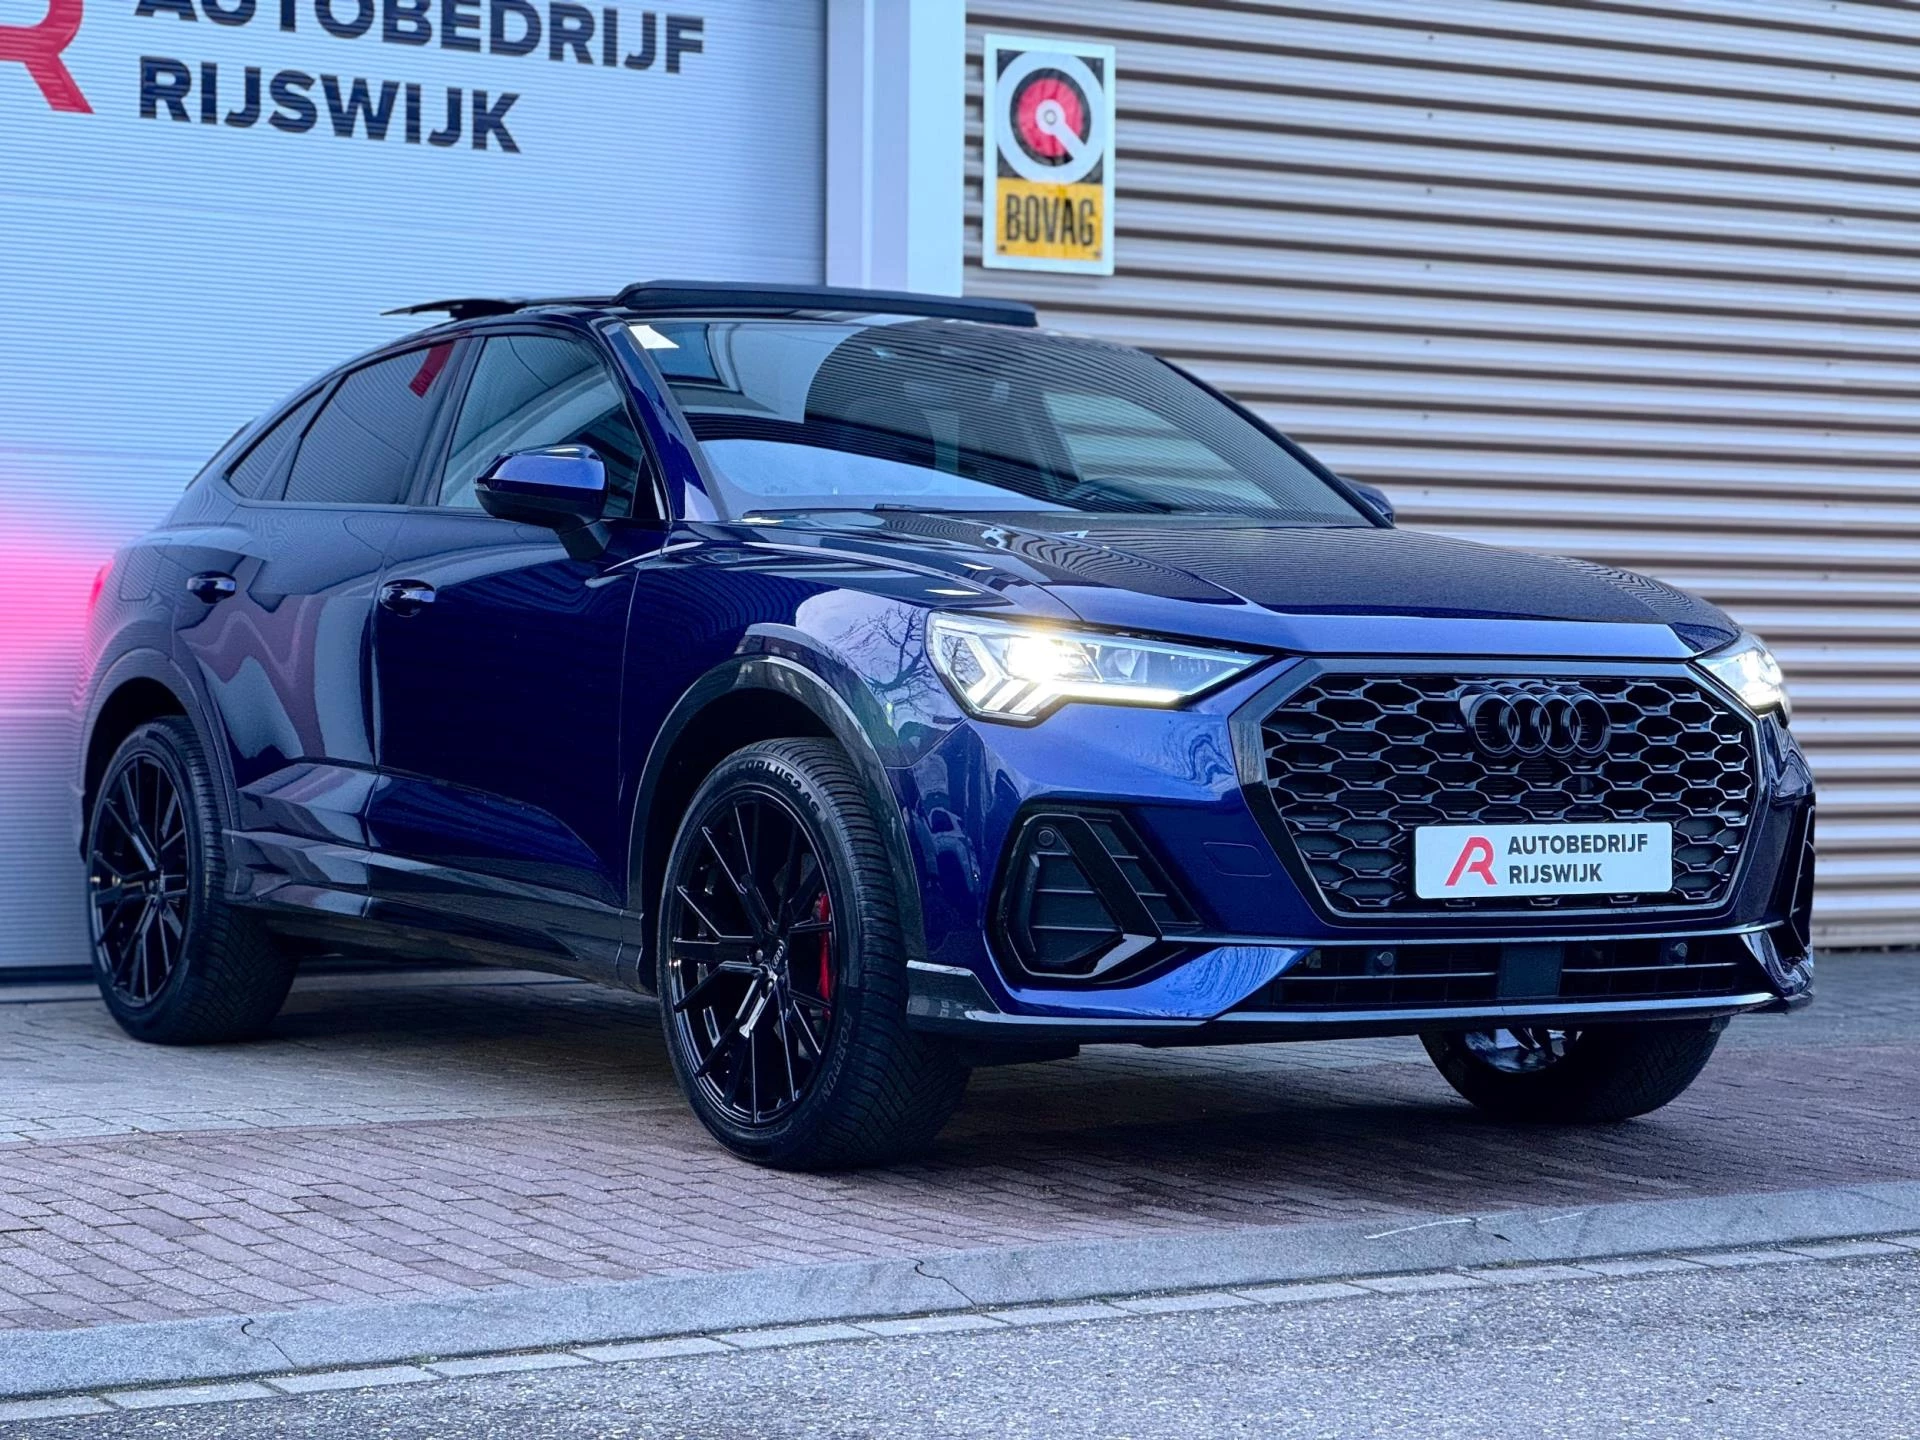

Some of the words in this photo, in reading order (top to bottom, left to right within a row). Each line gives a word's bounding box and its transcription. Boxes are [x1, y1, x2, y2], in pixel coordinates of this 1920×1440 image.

[134, 0, 704, 74] OBEDRIJF
[139, 56, 521, 154] RIJSWIJK
[1005, 194, 1095, 246] BOVAG
[1507, 833, 1649, 855] AUTOBEDRIJF
[1509, 863, 1603, 884] RIJSWIJK
